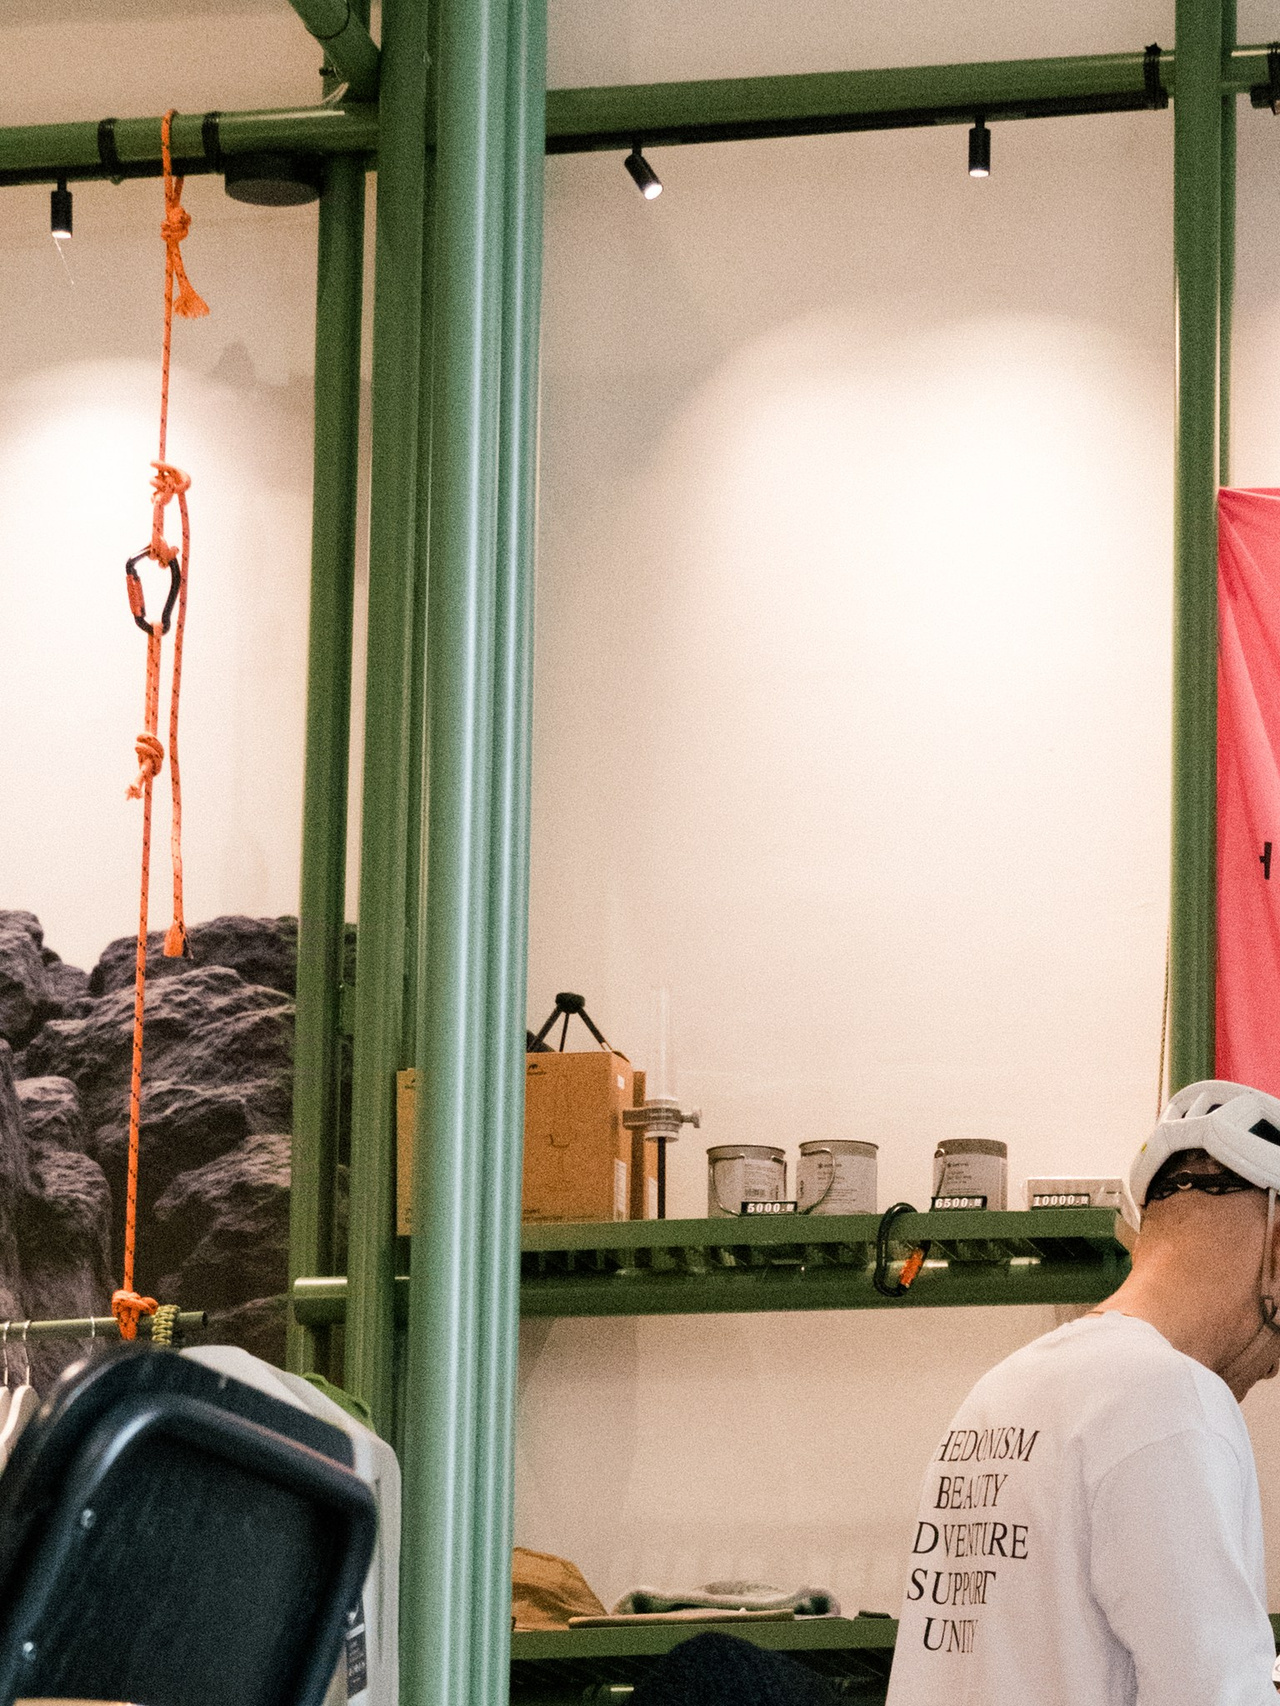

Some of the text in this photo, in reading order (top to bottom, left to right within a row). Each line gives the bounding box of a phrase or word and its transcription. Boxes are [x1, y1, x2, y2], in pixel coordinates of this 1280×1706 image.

[933, 1473, 1009, 1510] BEAUTY
[912, 1521, 1029, 1560] DVENTURE
[906, 1567, 997, 1606] SUPPORT
